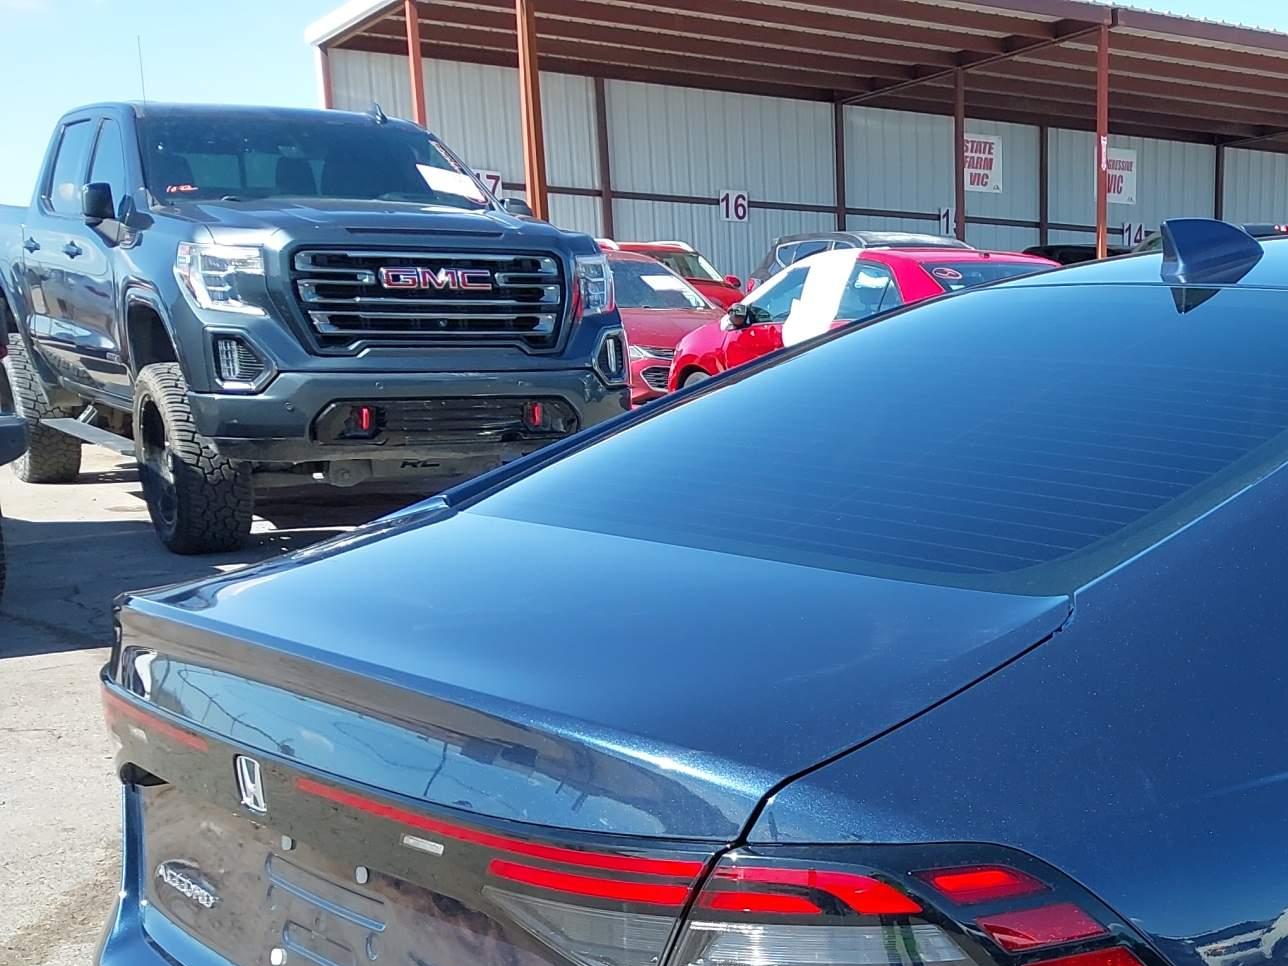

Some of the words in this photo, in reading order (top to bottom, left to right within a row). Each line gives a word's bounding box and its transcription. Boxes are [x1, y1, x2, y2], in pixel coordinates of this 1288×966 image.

[964, 139, 994, 155] STATE
[964, 156, 993, 171] FARM
[969, 172, 989, 187] VIC
[1107, 173, 1123, 195] VIC
[721, 192, 746, 220] 16
[1124, 223, 1143, 248] 14
[380, 267, 492, 291] GMC
